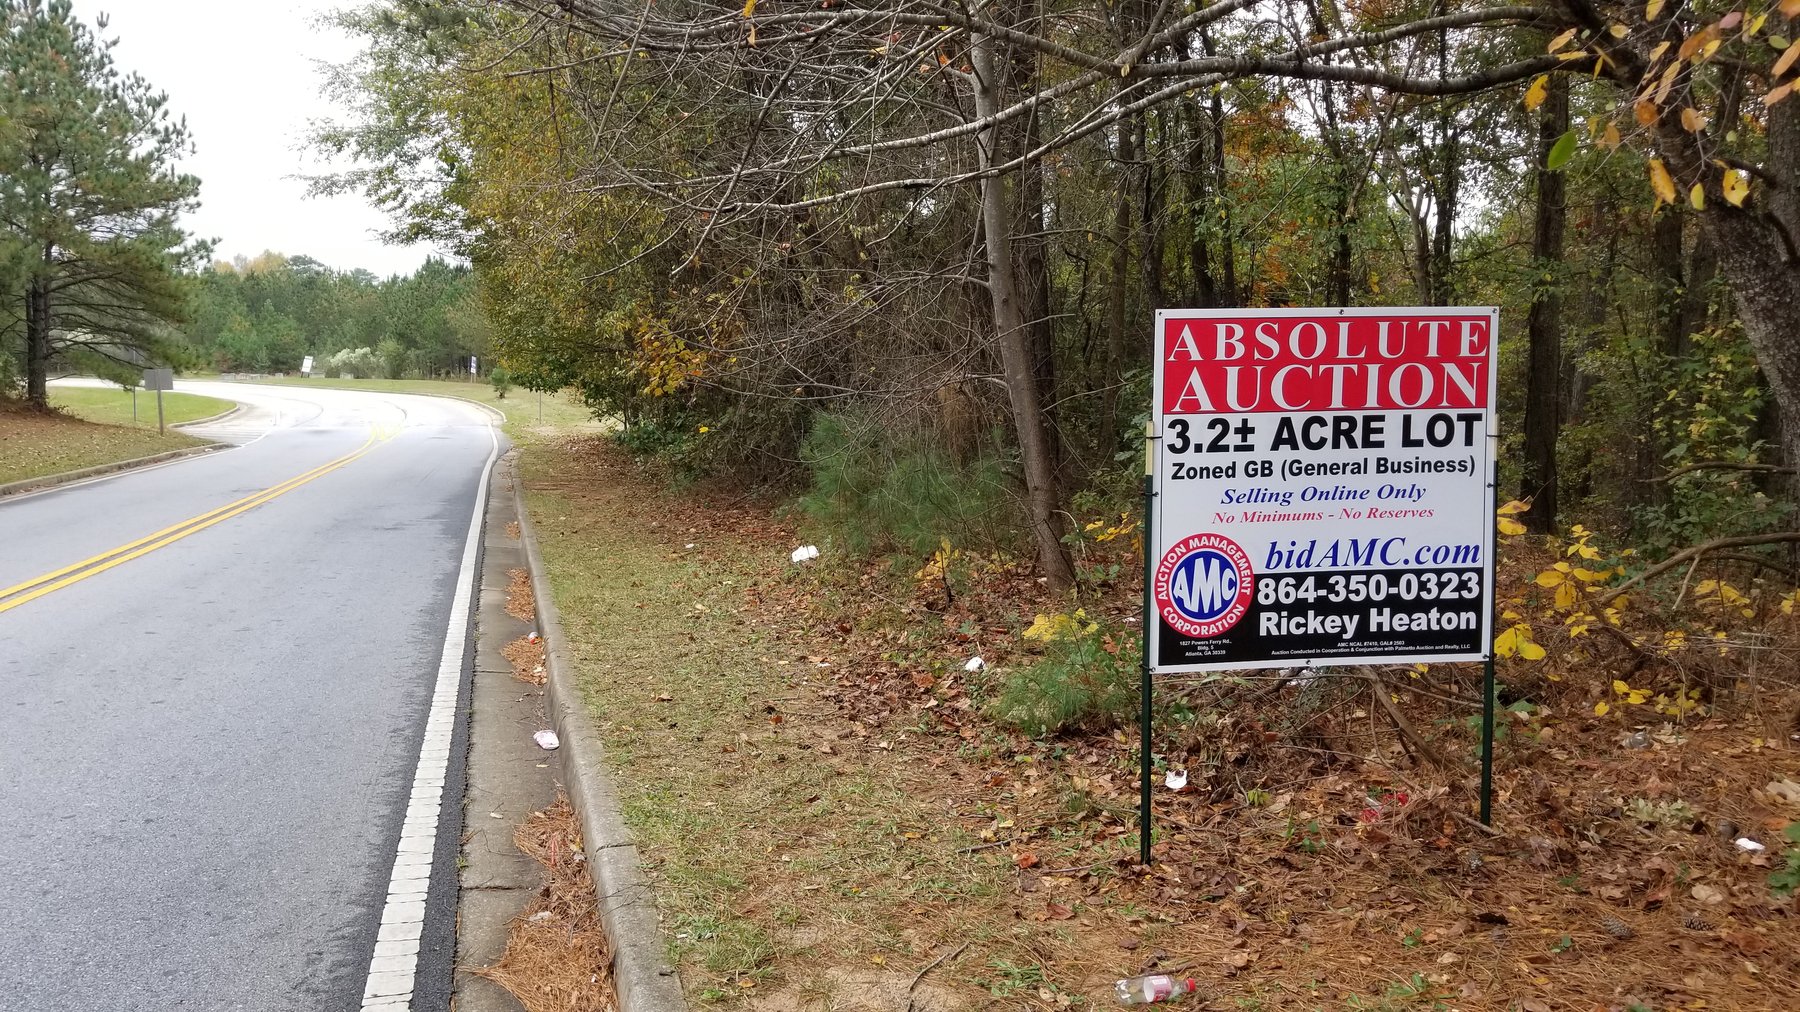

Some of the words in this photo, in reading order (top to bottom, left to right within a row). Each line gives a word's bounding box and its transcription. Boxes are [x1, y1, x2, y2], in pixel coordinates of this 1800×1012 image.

[1167, 321, 1487, 361] ABSOLUTE
[1171, 363, 1482, 412] AUCTION
[1167, 418, 1256, 454] 3.2±
[1270, 415, 1385, 451] ACRE
[1401, 413, 1483, 448] LOT
[1171, 461, 1237, 480] Zoned
[1243, 460, 1274, 477] GB
[1281, 457, 1368, 481] (General
[1375, 455, 1476, 477] Business)
[1220, 488, 1294, 507] Selling
[1300, 486, 1370, 502] Online
[1377, 483, 1426, 503] Only
[1212, 512, 1235, 525] No
[1240, 510, 1324, 523] Minimums
[1339, 508, 1362, 520] No
[1366, 507, 1435, 519] Reserves
[1157, 544, 1187, 600] AUCTION
[1189, 536, 1252, 595] MANAGEMENT
[1265, 537, 1481, 570] bidAMC.com
[1173, 557, 1236, 614] AMC
[1257, 573, 1480, 605] 864-350-0323
[1163, 603, 1245, 635] CORPORATION
[1259, 610, 1360, 640] Rickey
[1369, 607, 1477, 632] Heaton
